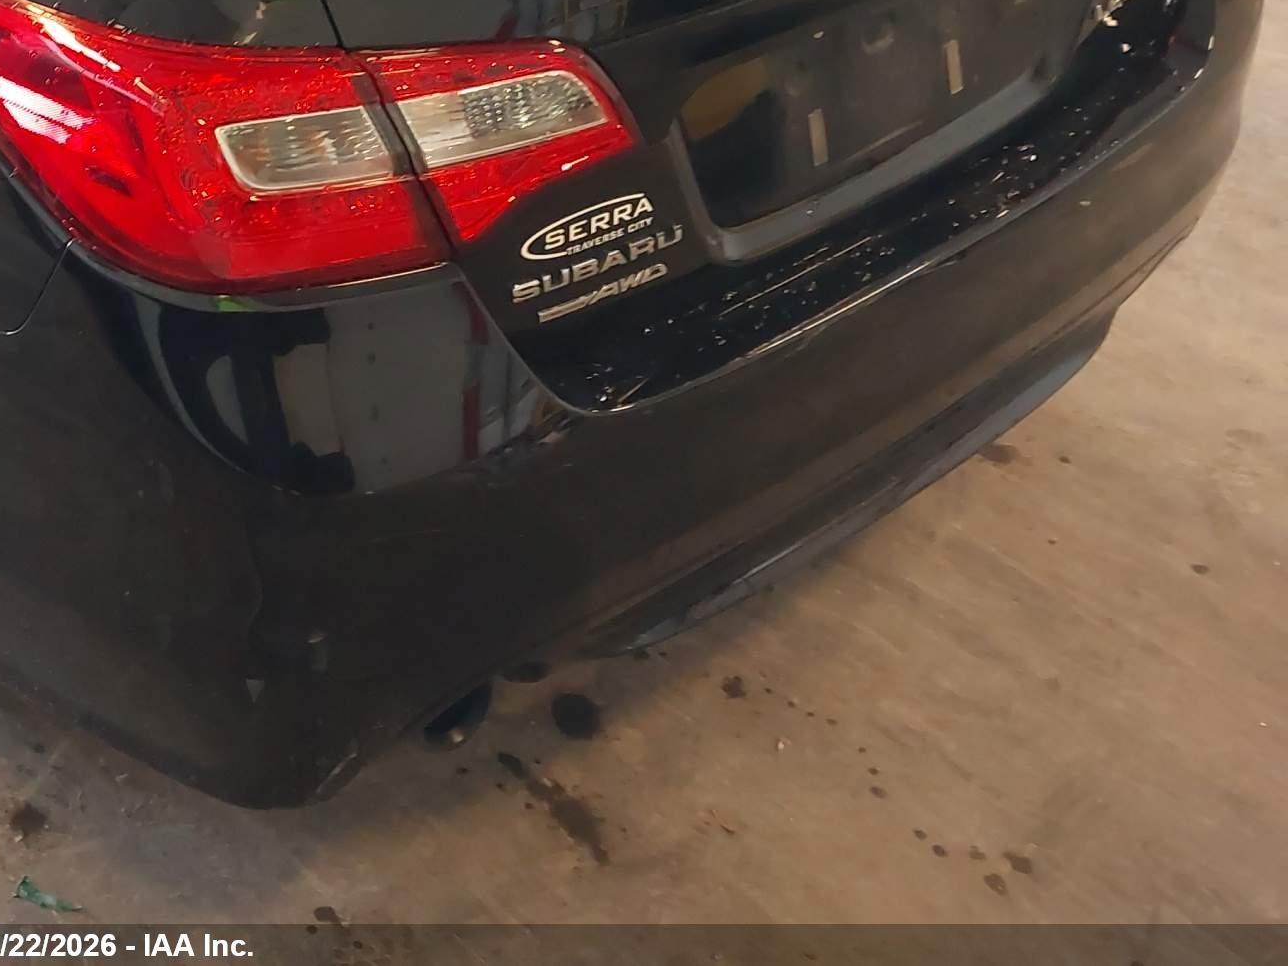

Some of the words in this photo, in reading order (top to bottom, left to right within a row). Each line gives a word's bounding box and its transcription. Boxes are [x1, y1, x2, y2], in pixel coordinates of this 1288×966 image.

[544, 197, 654, 251] SERRA
[566, 228, 625, 256] TRAVERSE
[627, 216, 654, 233] CITY
[512, 224, 684, 304] SUBARU
[588, 263, 668, 306] AWD
